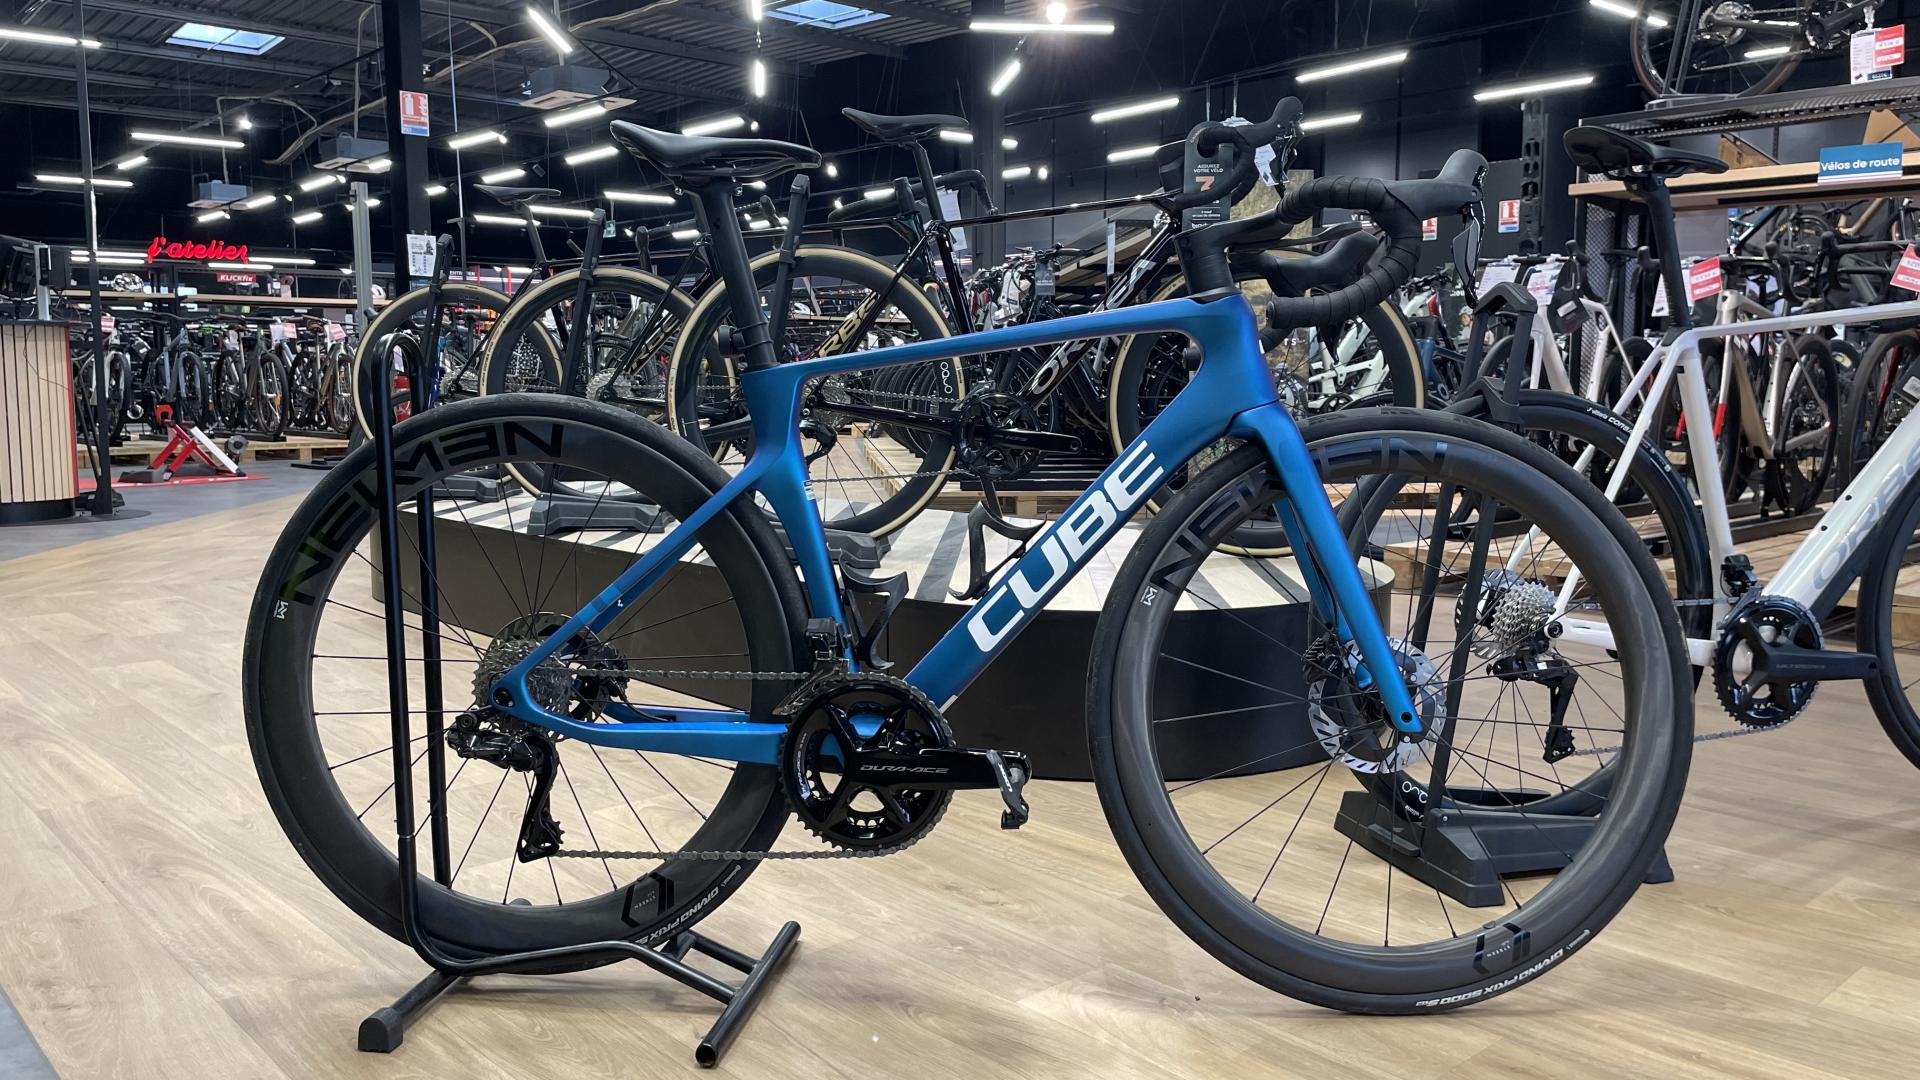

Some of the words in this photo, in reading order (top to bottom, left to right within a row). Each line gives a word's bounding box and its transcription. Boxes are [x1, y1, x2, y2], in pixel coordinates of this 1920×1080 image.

[1821, 160, 1851, 171] Vélos
[1852, 159, 1867, 169] de
[1869, 157, 1900, 167] route
[147, 236, 249, 264] l'atelier
[1030, 259, 1157, 395] OREA
[1812, 447, 1920, 590] ORBE
[967, 440, 1164, 652] CUBE
[859, 763, 950, 775] DURA-ACE
[680, 886, 720, 922] GRAND
[649, 918, 680, 941] PRIX
[1518, 948, 1564, 980] GRAND
[1439, 988, 1484, 1006] 5000
[1483, 975, 1519, 995] PRIX
